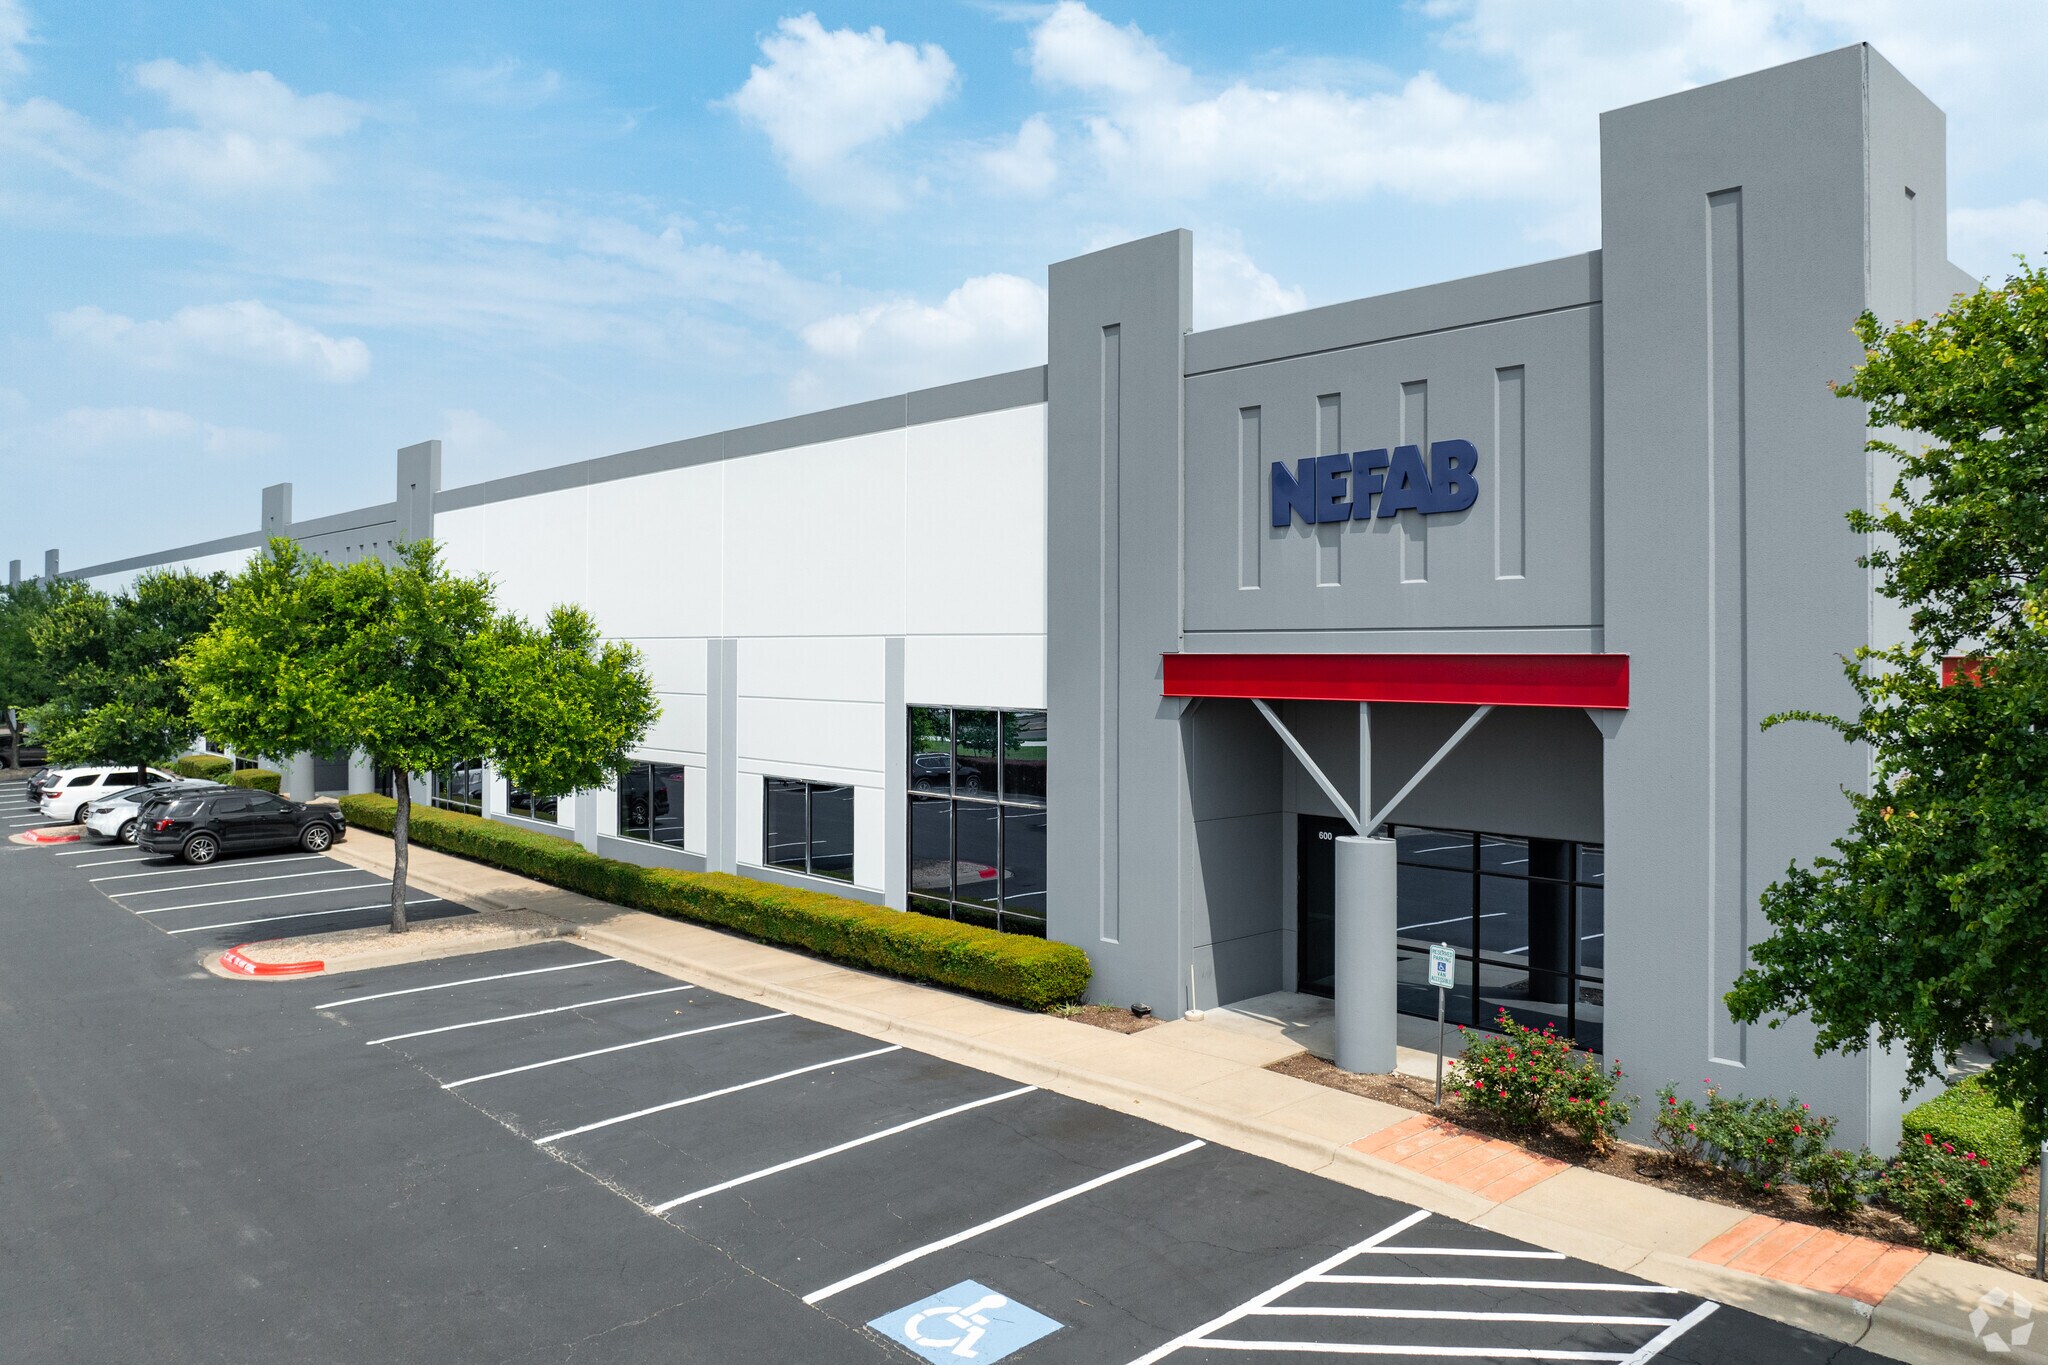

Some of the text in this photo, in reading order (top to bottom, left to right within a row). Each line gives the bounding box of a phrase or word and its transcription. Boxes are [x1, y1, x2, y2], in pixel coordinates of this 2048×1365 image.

[1272, 439, 1478, 527] NEFAB
[1318, 831, 1332, 840] 600
[1432, 949, 1452, 957] RESERVED
[1433, 955, 1451, 963] PARKING
